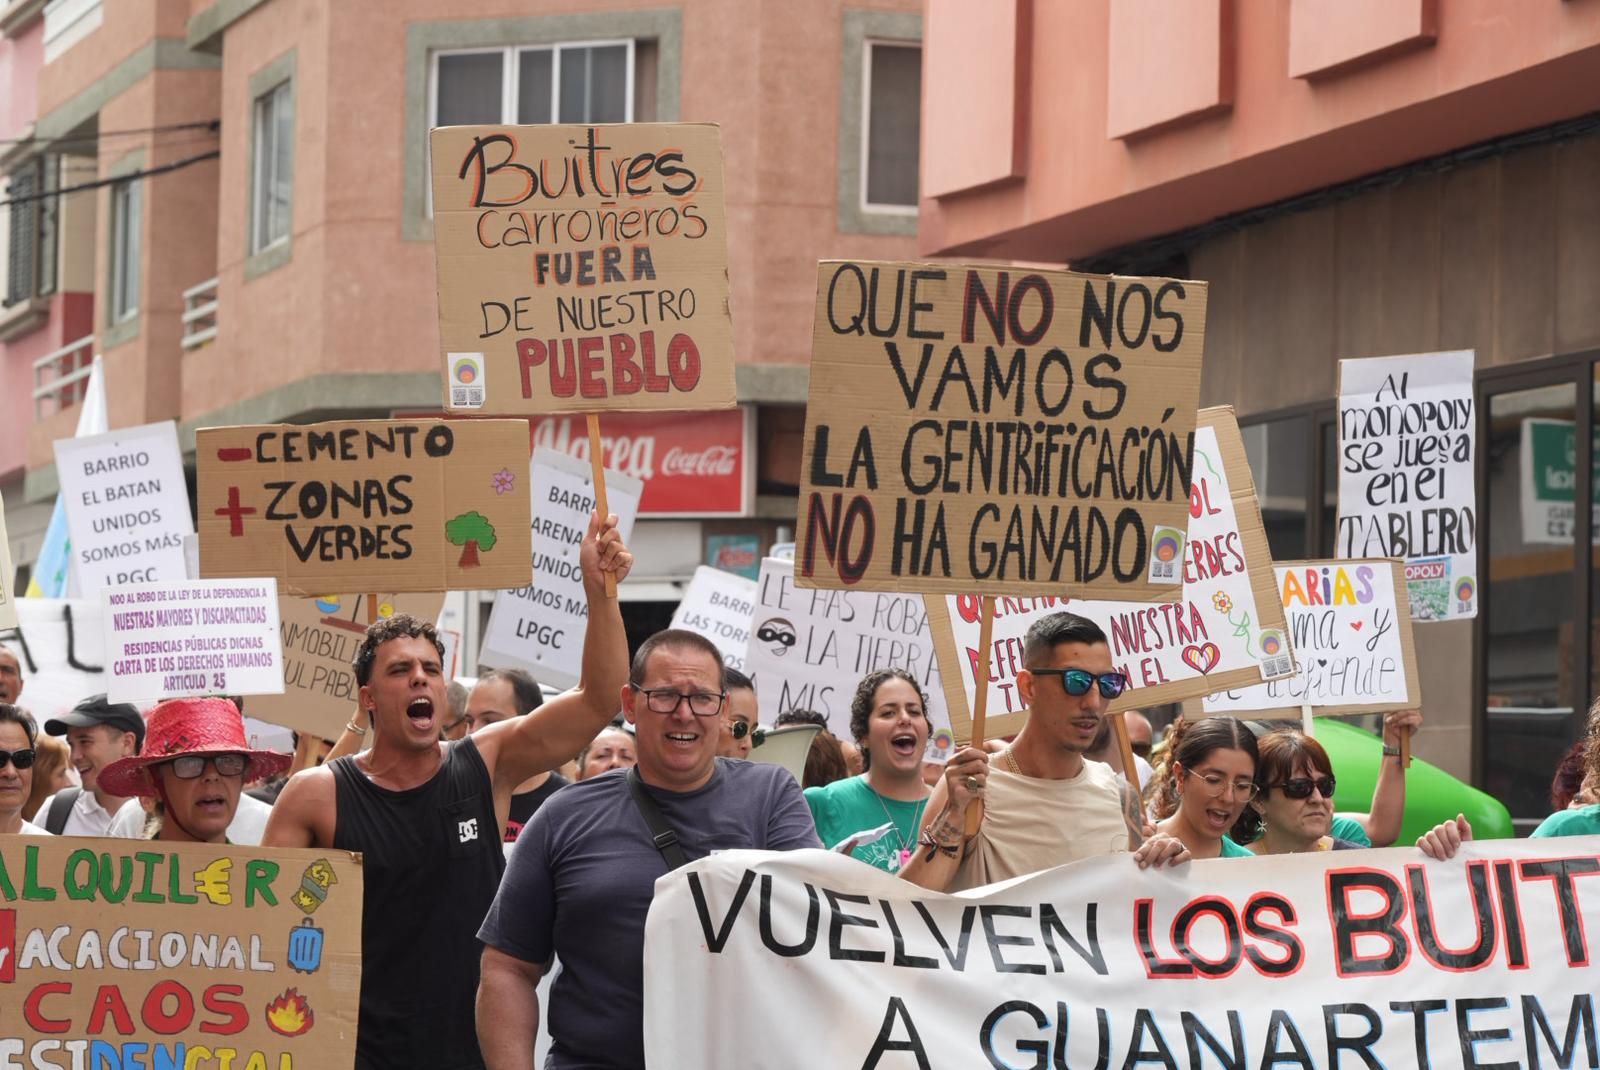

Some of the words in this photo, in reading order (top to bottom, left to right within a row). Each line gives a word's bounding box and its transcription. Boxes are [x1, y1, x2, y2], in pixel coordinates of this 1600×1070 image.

[459, 128, 704, 208] Buitres
[533, 243, 657, 288] FUERA
[480, 297, 534, 339] DE
[556, 288, 696, 332] NUESTRO
[827, 263, 947, 340] QUE
[961, 270, 1054, 347] NO
[1079, 280, 1186, 352] NOS
[516, 330, 701, 399] PUEBLO
[884, 341, 1127, 420] VAMOS
[256, 425, 454, 463] CEMENTO
[810, 424, 878, 490] LA
[1344, 442, 1384, 473] se
[83, 452, 150, 476] BARRIO
[82, 491, 101, 506] EL
[106, 479, 161, 502] BATAN
[264, 475, 413, 520] ZONAS
[548, 486, 597, 515] BARRI
[1366, 471, 1408, 506] en
[1415, 467, 1445, 501] el
[93, 508, 161, 533] UNIDOS
[801, 491, 876, 584] NO
[891, 497, 951, 577] HA
[968, 502, 1146, 584] GANADO
[1339, 506, 1475, 559] TABLERO
[82, 541, 141, 563] SOMOS
[146, 532, 182, 552] MÁS
[285, 523, 413, 562] VERDES
[1184, 531, 1245, 584] ERDES
[532, 552, 582, 583] UNIDO
[1405, 564, 1444, 579] OPOLY
[137, 591, 155, 603] ROBO
[158, 591, 167, 601] DE
[169, 590, 177, 600] LA
[179, 589, 190, 600] LEY
[192, 589, 200, 599] DE
[203, 588, 211, 599] LA
[213, 588, 260, 599] DEPENDENCIA
[262, 587, 267, 597] A
[709, 591, 755, 617] BARRI
[761, 573, 794, 611] LE
[810, 588, 855, 623] HAS
[114, 611, 155, 631] NUESTRAS
[157, 608, 193, 627] MAYORES
[195, 609, 200, 625] Y
[202, 606, 267, 625] DISCAPACITADAS
[516, 617, 565, 649] LPGC
[683, 611, 711, 631] LAS
[1110, 601, 1208, 657] NUESTRA
[114, 658, 142, 676] CARTA
[145, 658, 157, 672] DE
[159, 656, 175, 672] LOS
[178, 654, 224, 671] DERECHOS
[227, 652, 272, 668] HUMANOS
[124, 639, 182, 656] RESIDENCIAS
[185, 634, 227, 652] PÚBLICAS
[229, 637, 263, 650] DIGNAS
[804, 625, 839, 669] LA
[163, 674, 206, 691] ARTICULO
[213, 673, 226, 689] 25
[284, 656, 358, 702] ULPABL
[1140, 657, 1170, 687] EL
[687, 868, 1109, 976] VUELVEN
[1133, 891, 1305, 979] LOS
[1324, 854, 1600, 979] BUIT
[23, 979, 250, 1035] CAOS
[861, 996, 932, 1070] A
[980, 993, 1600, 1070] GUANARTEM
